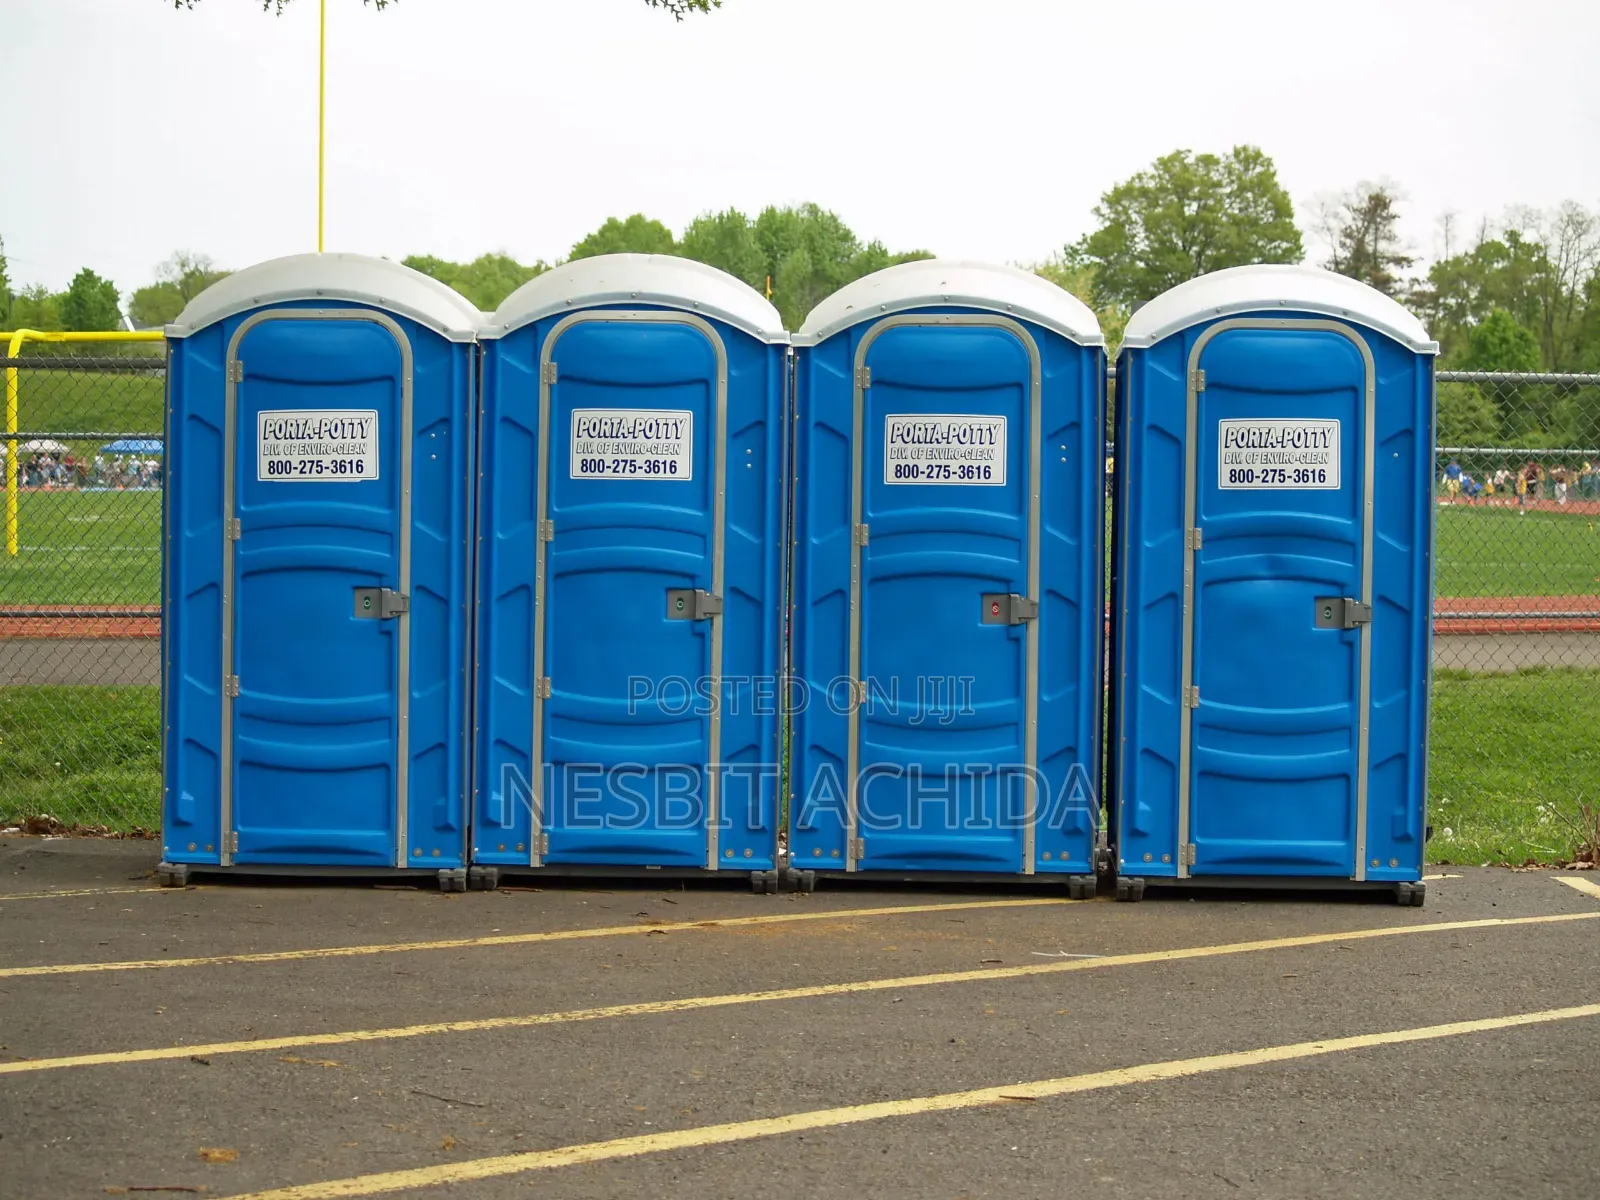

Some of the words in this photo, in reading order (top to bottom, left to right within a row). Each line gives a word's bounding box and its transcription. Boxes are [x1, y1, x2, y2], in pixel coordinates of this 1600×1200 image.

[263, 417, 372, 440] PORTA-POTTY
[577, 417, 687, 440] PORTA-POTTY
[891, 422, 1001, 445] PORTA-POTTY
[1225, 427, 1334, 449] PORTA-POTTY
[283, 443, 297, 456] OF
[298, 443, 367, 455] ENVIRO-CLEAN
[597, 442, 611, 454] OF
[611, 442, 681, 455] ENVIRO-CLEAN
[911, 448, 925, 460] OF
[925, 448, 995, 460] ENVIRO-CLEAN
[1245, 452, 1259, 464] OF
[1260, 452, 1329, 465] ENVIRO-CLEAN
[268, 459, 364, 475] 800-275-3616
[581, 459, 677, 475] 800-275-3616
[895, 464, 991, 480] 800-275-3616
[1229, 469, 1326, 484] 800-275-3616
